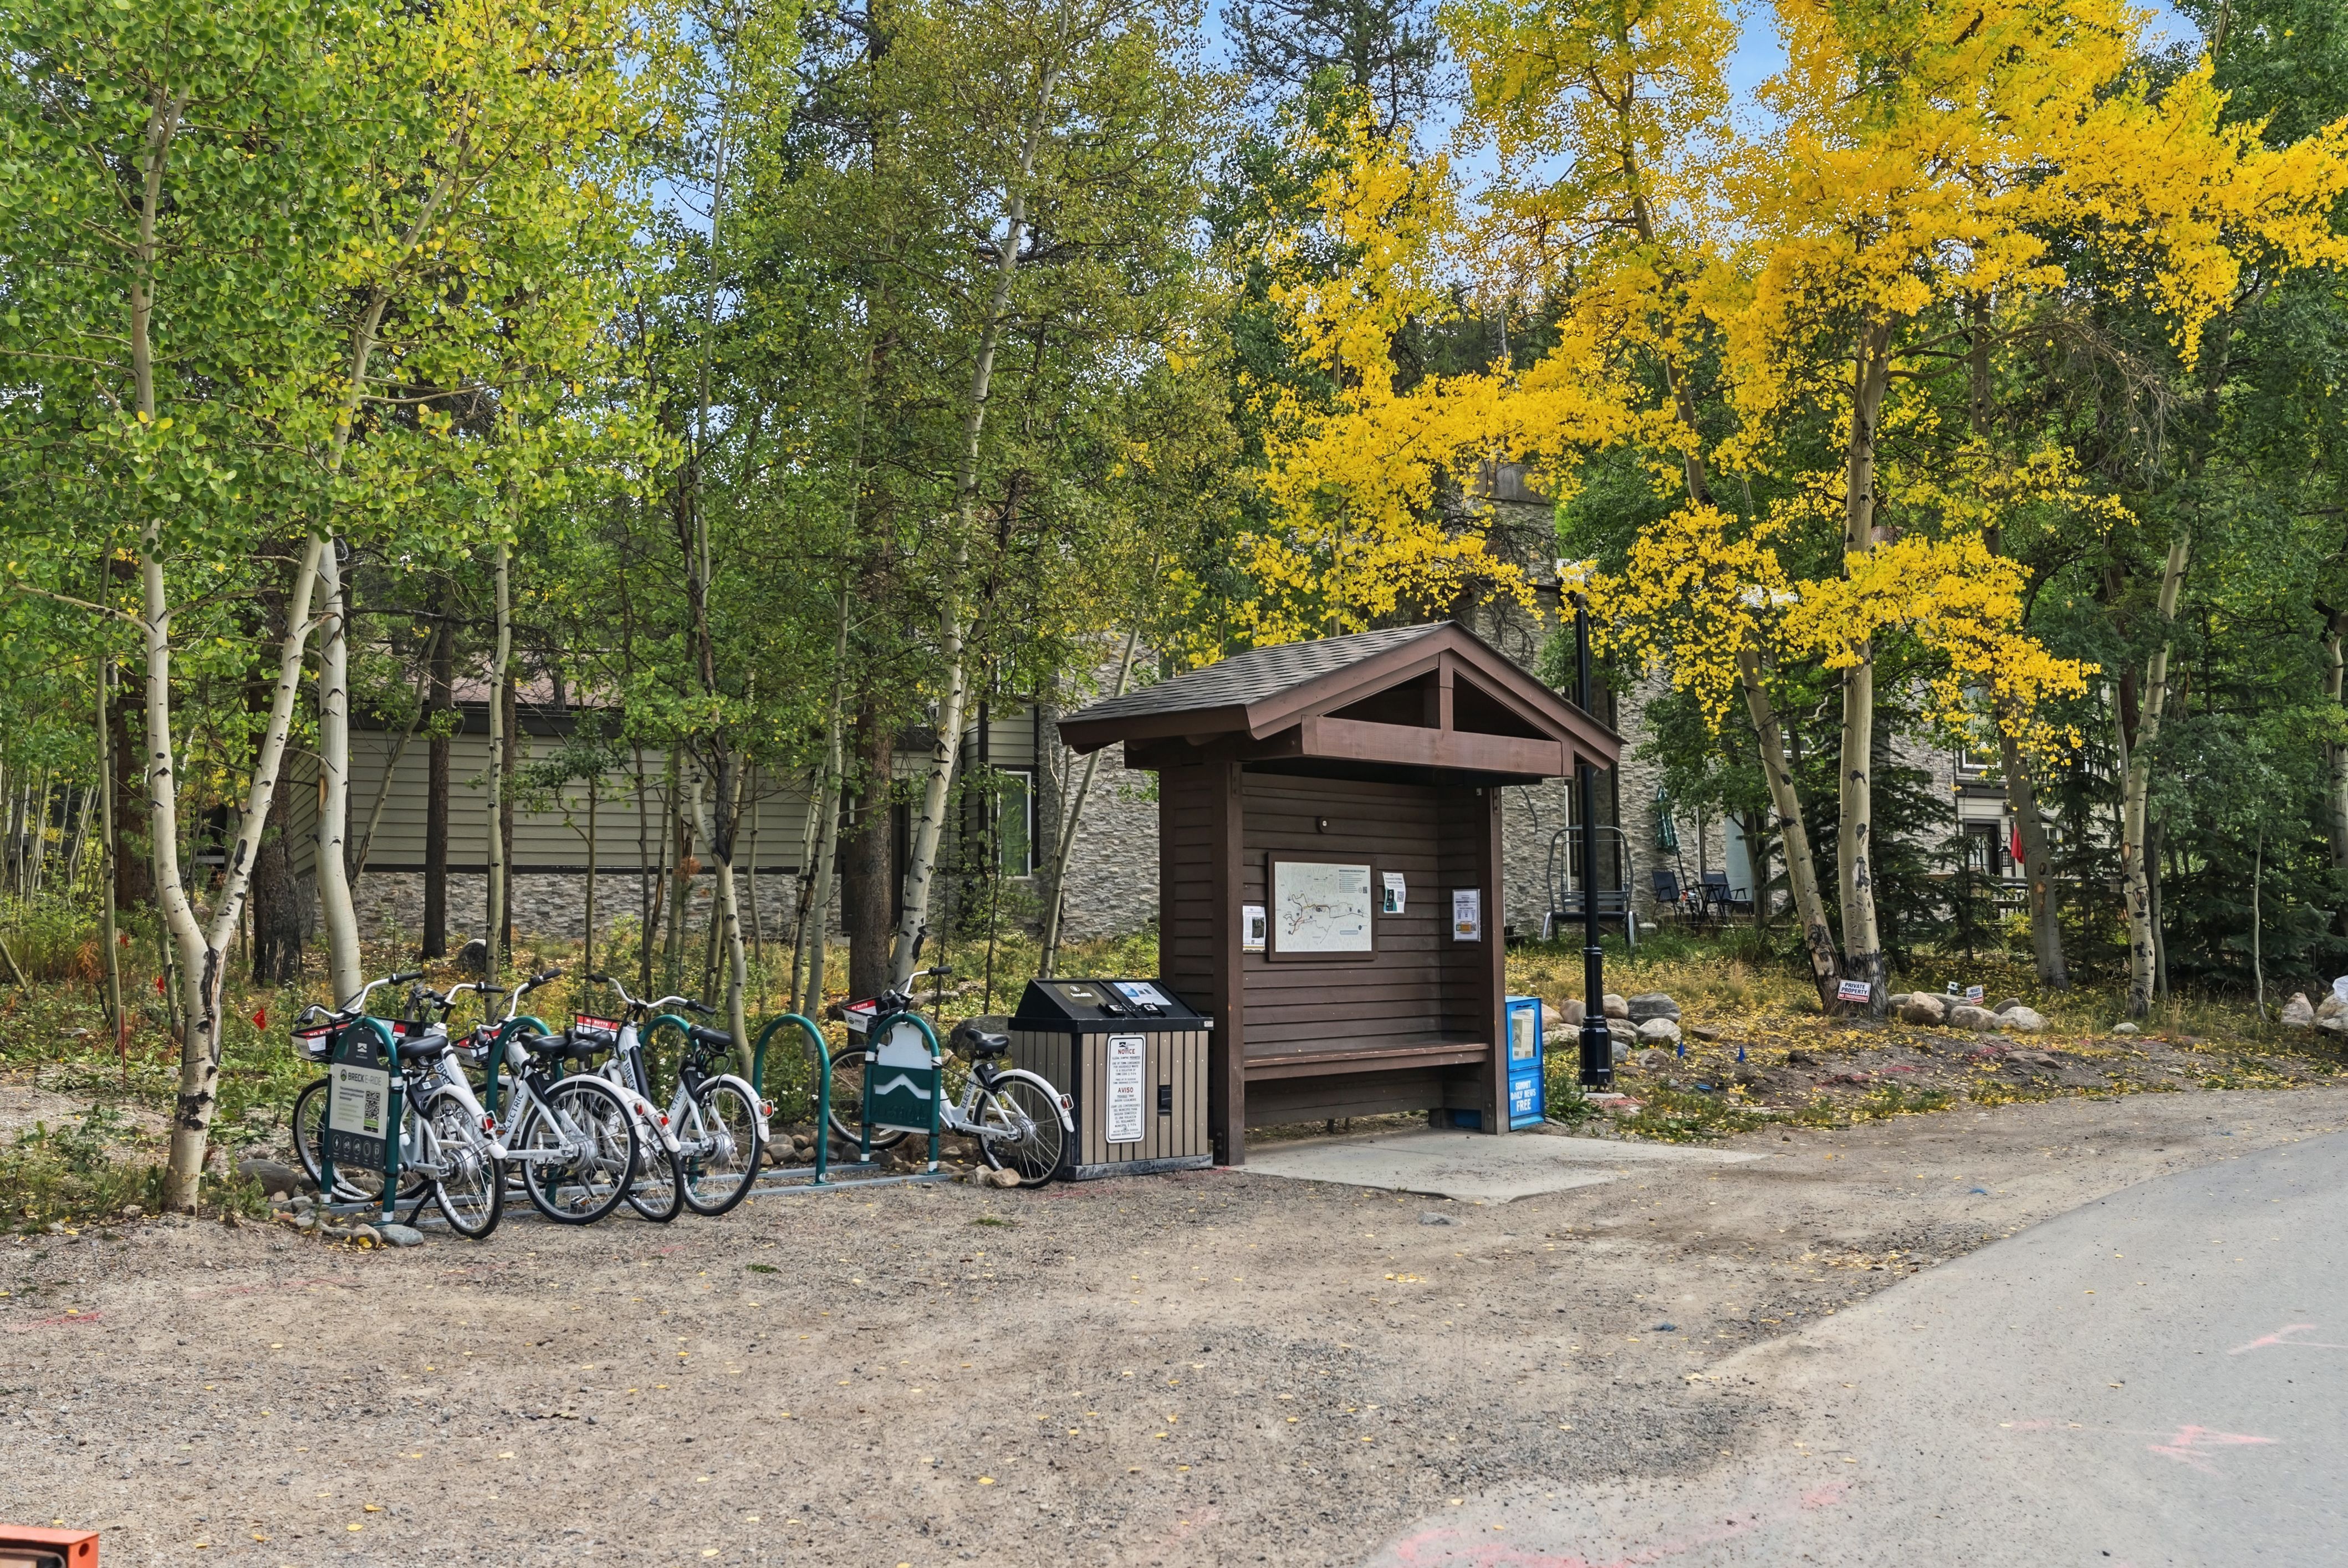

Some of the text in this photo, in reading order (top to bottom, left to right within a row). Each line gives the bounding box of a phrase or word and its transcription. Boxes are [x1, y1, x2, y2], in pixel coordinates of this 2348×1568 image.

[1841, 987, 1867, 995] PROPERTY
[348, 1072, 382, 1086] BRECK E-RIDE
[437, 1063, 451, 1085] BRE
[1510, 1088, 1536, 1101] DAILY NEWS
[1517, 1098, 1532, 1112] FREE
[506, 1092, 524, 1134] ELECTRIC
